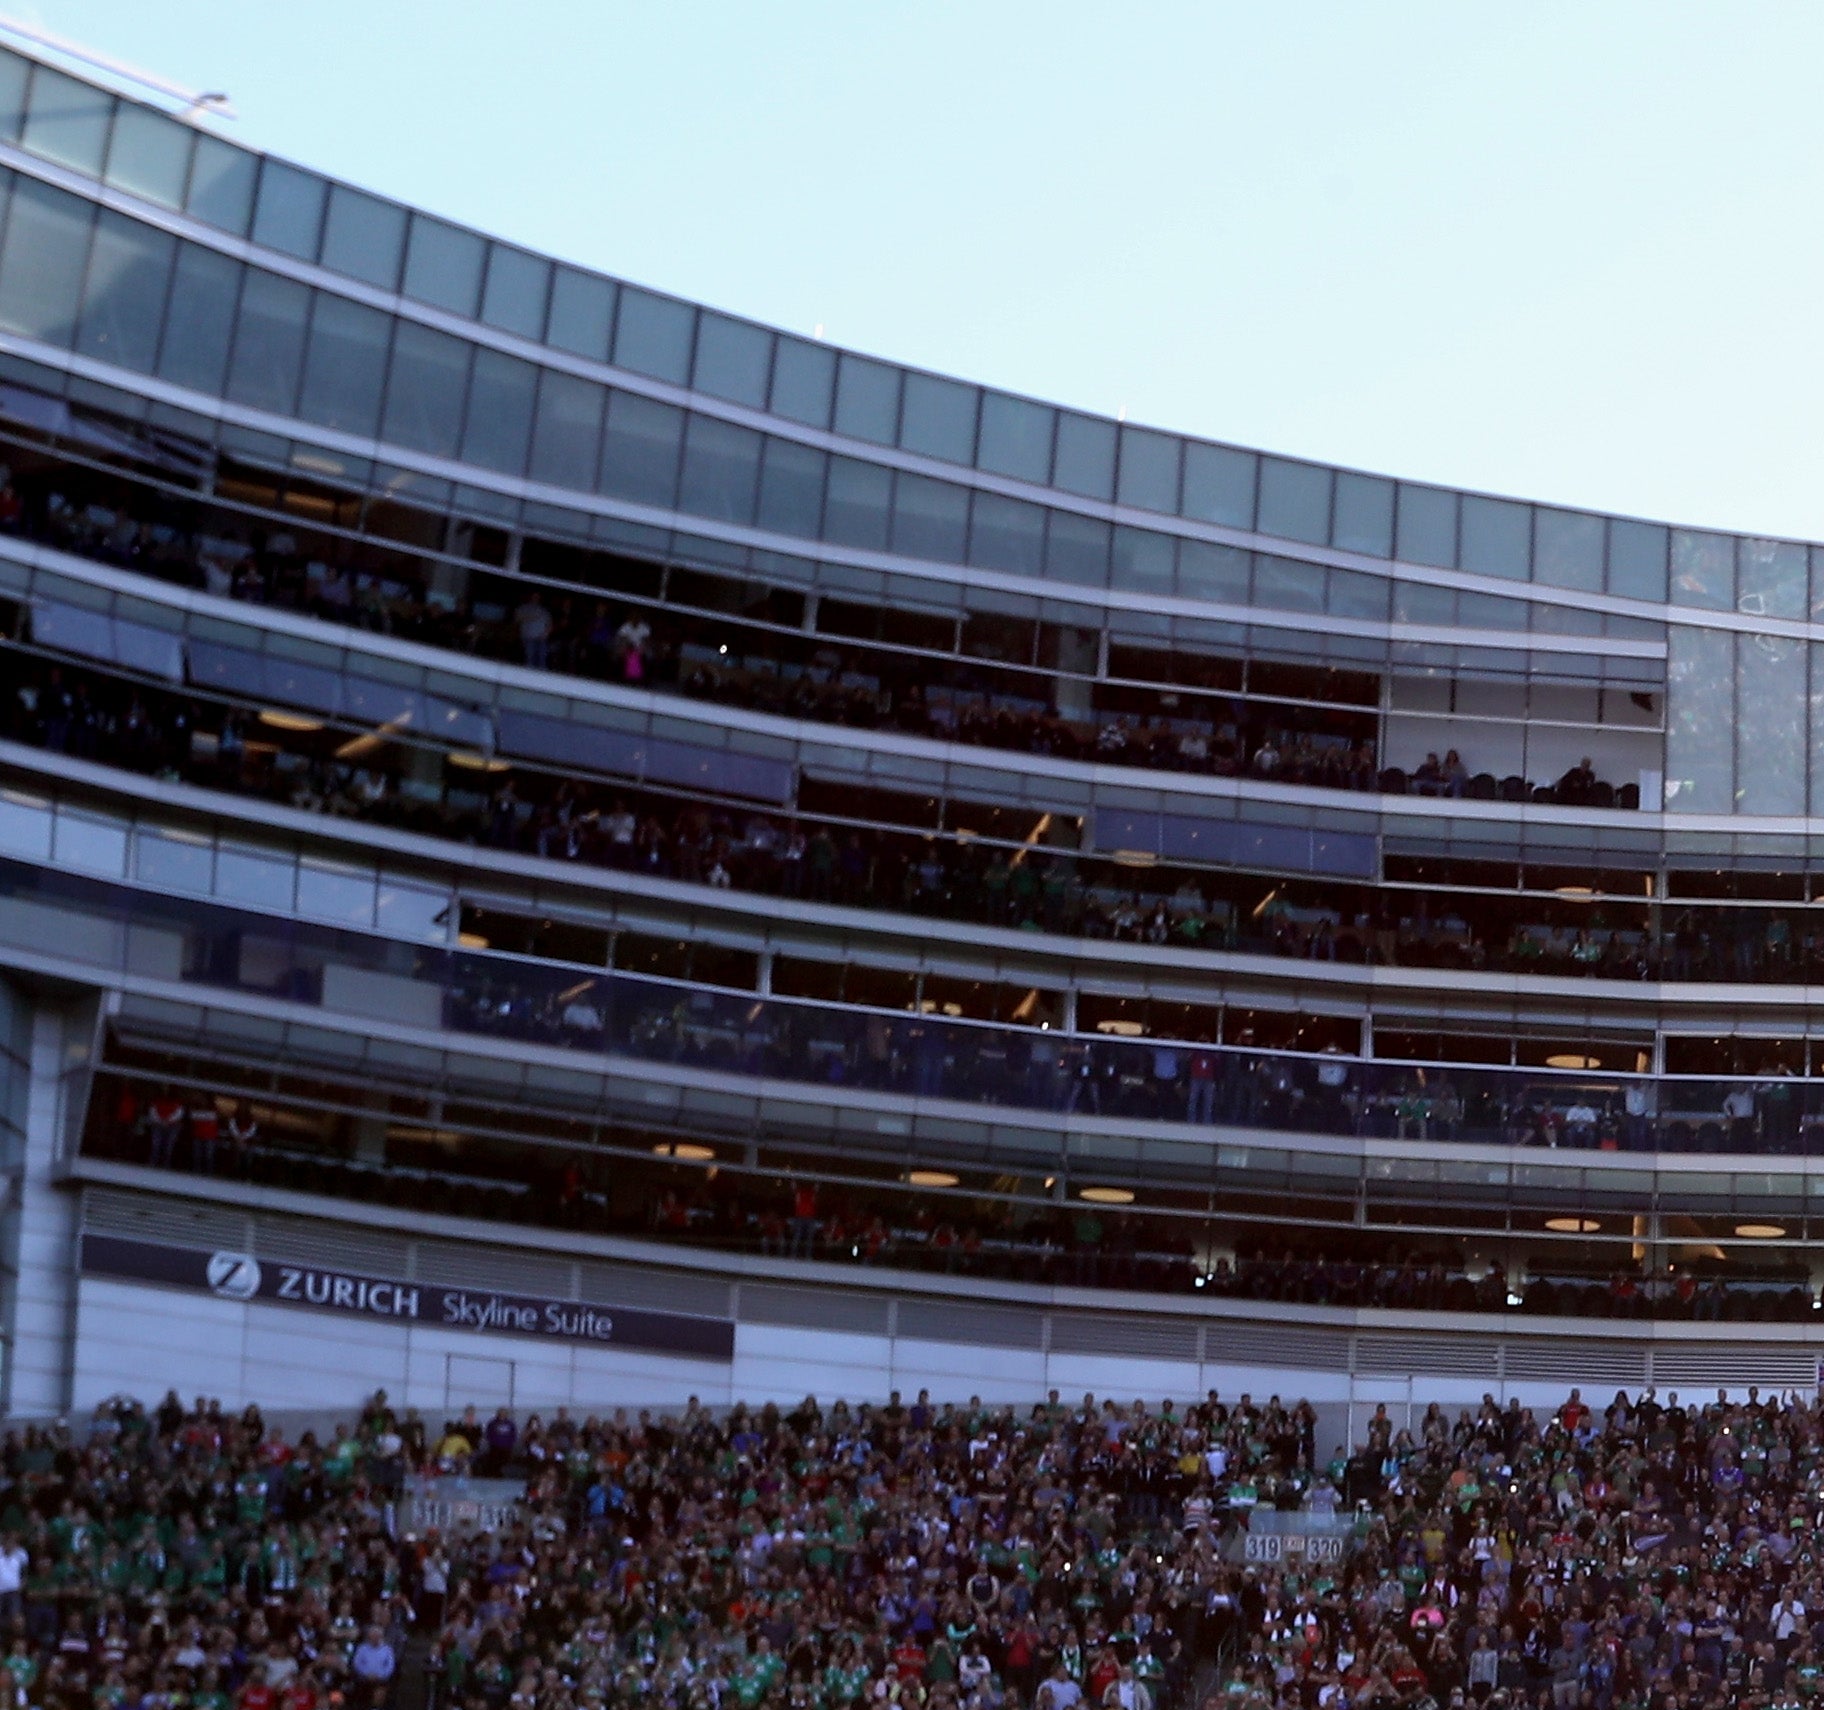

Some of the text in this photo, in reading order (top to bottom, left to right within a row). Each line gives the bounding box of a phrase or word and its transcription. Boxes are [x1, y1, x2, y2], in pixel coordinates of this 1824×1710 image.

[278, 1267, 613, 1339] ZURICH Skyline Suite
[1246, 1537, 1279, 1559] 319
